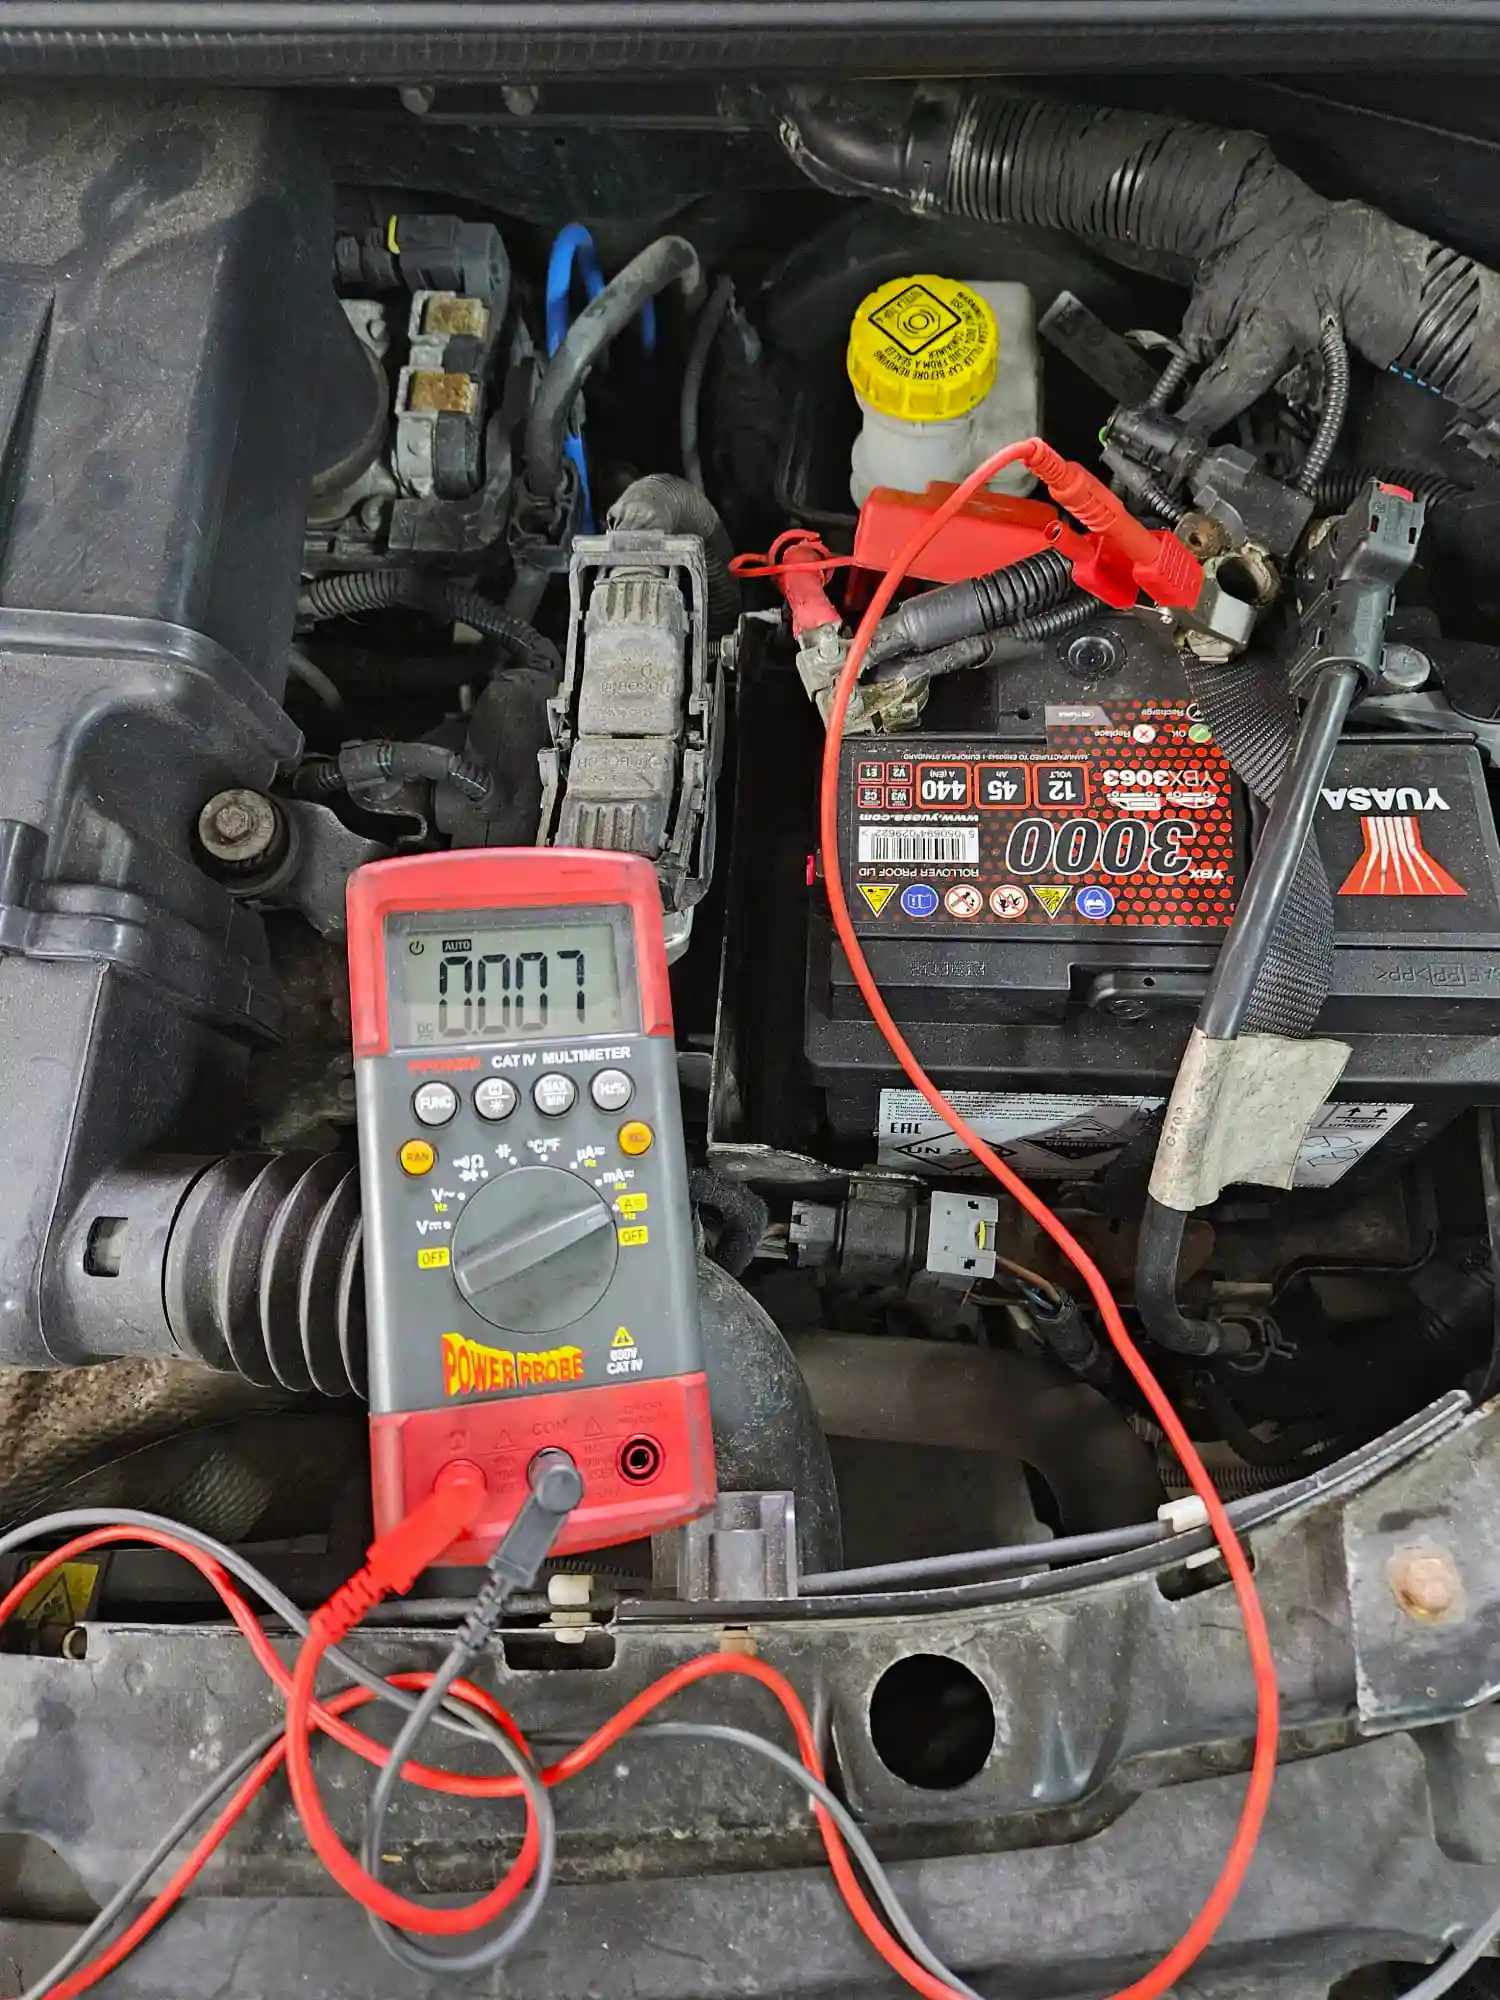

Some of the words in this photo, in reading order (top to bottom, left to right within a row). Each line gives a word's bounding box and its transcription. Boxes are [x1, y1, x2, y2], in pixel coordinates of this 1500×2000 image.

[884, 345, 912, 366] SEALED
[873, 350, 912, 378] REMOVING
[915, 360, 921, 370] A
[922, 358, 948, 370] FROM
[948, 363, 966, 377] CAP
[913, 370, 946, 381] BEFORE
[1141, 708, 1185, 717] Recharge
[1094, 729, 1131, 738] Replace
[1171, 730, 1187, 738] OK
[904, 753, 941, 761] STANDARD
[942, 753, 980, 761] EUROPEAN
[1029, 753, 1089, 761] MANUFACTURED
[866, 768, 878, 777] E1
[892, 768, 906, 777] V2
[929, 769, 948, 778] (EN)
[948, 770, 956, 778] A
[995, 770, 1009, 778] Ah
[1048, 770, 1073, 779] VOLT
[1103, 769, 1217, 788] YBX3063
[921, 779, 966, 801] 440
[987, 780, 1018, 801] 45
[1048, 779, 1077, 801] 12
[864, 791, 878, 801] C2
[891, 791, 907, 801] W3
[1319, 787, 1451, 811] YUASA
[859, 812, 979, 822] www.yuasa.com
[875, 830, 916, 839] 029622
[968, 830, 975, 839] 5
[1005, 818, 1194, 877] 3000
[858, 867, 876, 877] LID
[879, 867, 917, 877] PROOF
[920, 867, 979, 877] ROLLOVER
[1188, 869, 1225, 879] YBX
[443, 940, 471, 952] AUTO
[439, 950, 585, 1037] 0.007
[417, 1023, 433, 1035] DC
[491, 1054, 521, 1069] CAT
[521, 1053, 537, 1067] IV
[542, 1046, 631, 1065] MULTIMETER
[419, 1096, 452, 1110] FUNC
[889, 1122, 922, 1135] EAC
[907, 1146, 941, 1155] UN
[622, 1229, 645, 1243] OFF
[422, 1251, 446, 1266] OFF
[442, 1332, 518, 1396] POWER
[516, 1345, 585, 1389] PROBE
[606, 1362, 630, 1375] CAT
[629, 1359, 644, 1372] IV
[531, 1418, 569, 1436] COM
